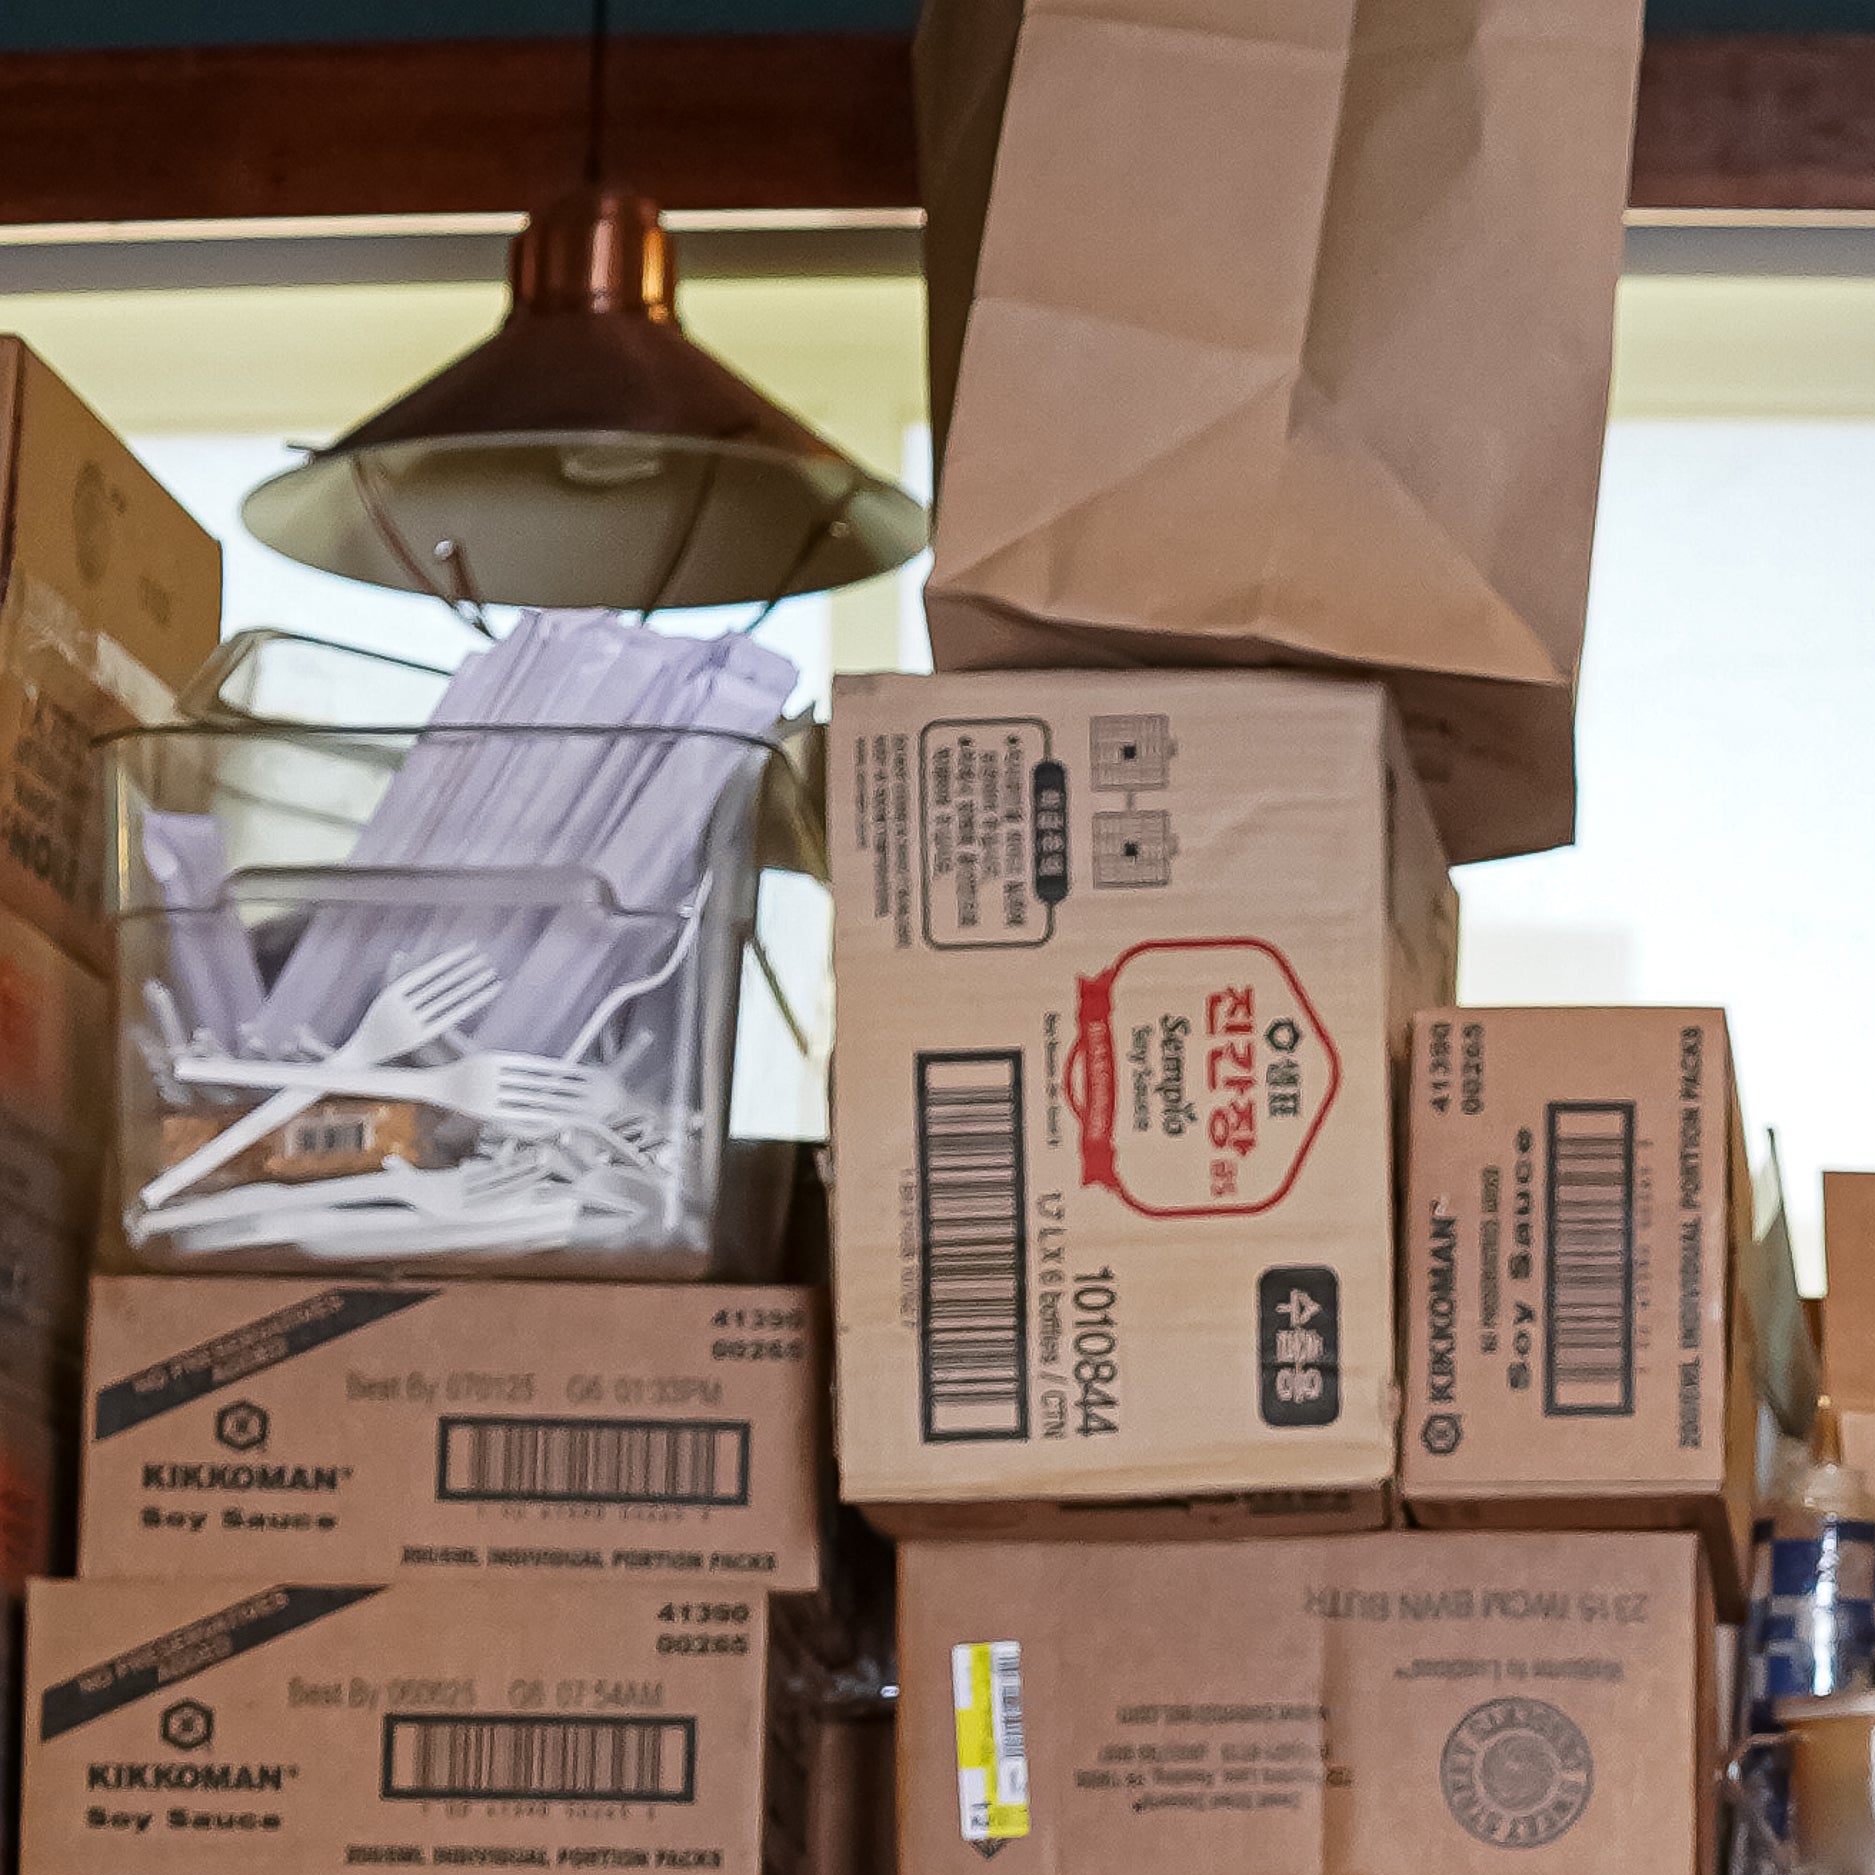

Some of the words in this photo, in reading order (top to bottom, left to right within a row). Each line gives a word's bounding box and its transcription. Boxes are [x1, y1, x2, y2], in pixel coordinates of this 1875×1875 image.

[1156, 1014, 1200, 1139] Sempio
[1206, 985, 1258, 1157] 진간장
[1507, 1125, 1534, 1281] Sauce
[1072, 1266, 1120, 1437] 1010844
[1428, 1214, 1458, 1403] KIKKOMAN
[1506, 1303, 1538, 1391] Soy
[141, 1506, 208, 1531] Soy
[221, 1505, 339, 1531] Sauce
[142, 1463, 339, 1490] KIKKOMAN
[86, 1763, 283, 1791] KIKKOMAN
[86, 1805, 152, 1832] Soy
[167, 1806, 282, 1831] Sauce
